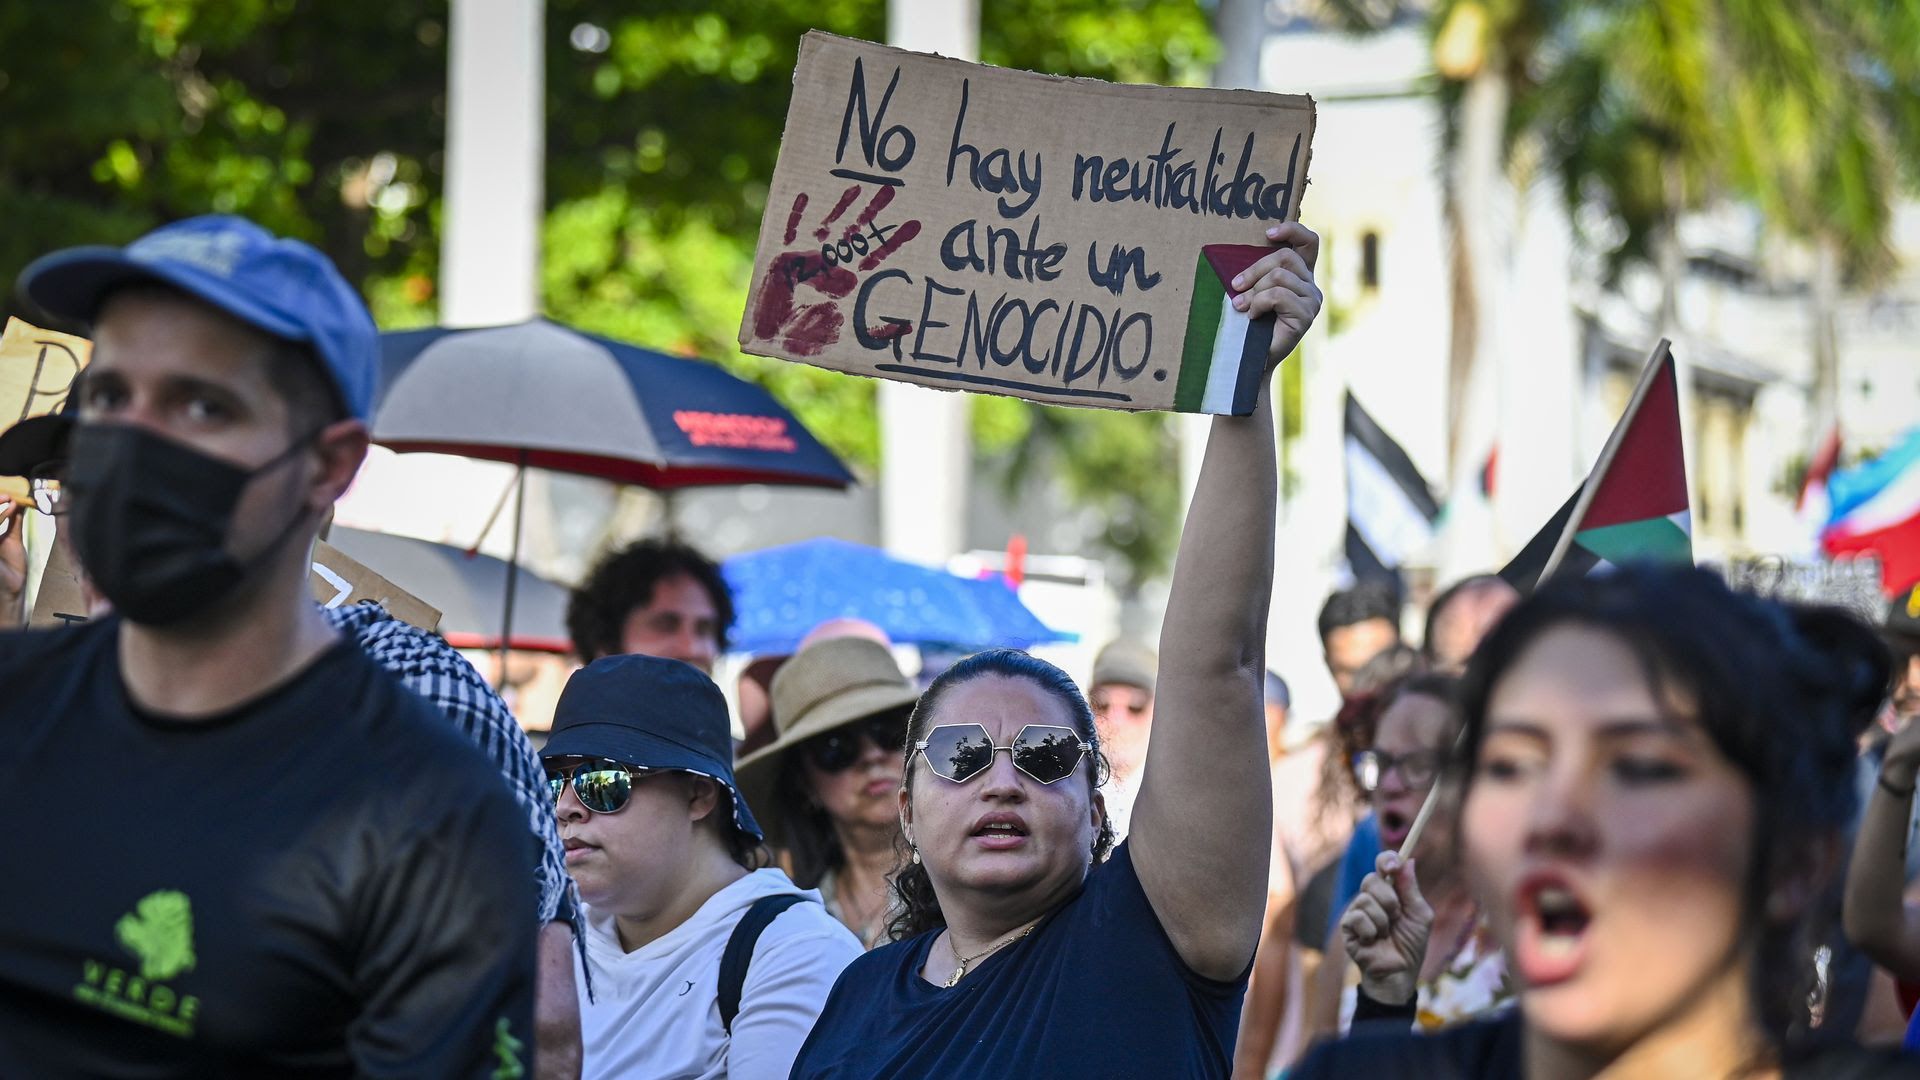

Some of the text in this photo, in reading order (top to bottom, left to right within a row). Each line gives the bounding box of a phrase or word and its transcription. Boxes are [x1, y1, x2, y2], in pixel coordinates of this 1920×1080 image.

[836, 56, 1301, 222] No hay neutralidad
[940, 214, 1163, 296] ante un
[853, 268, 1168, 389] GENOCIDIO.
[83, 958, 200, 1020] VERDE
